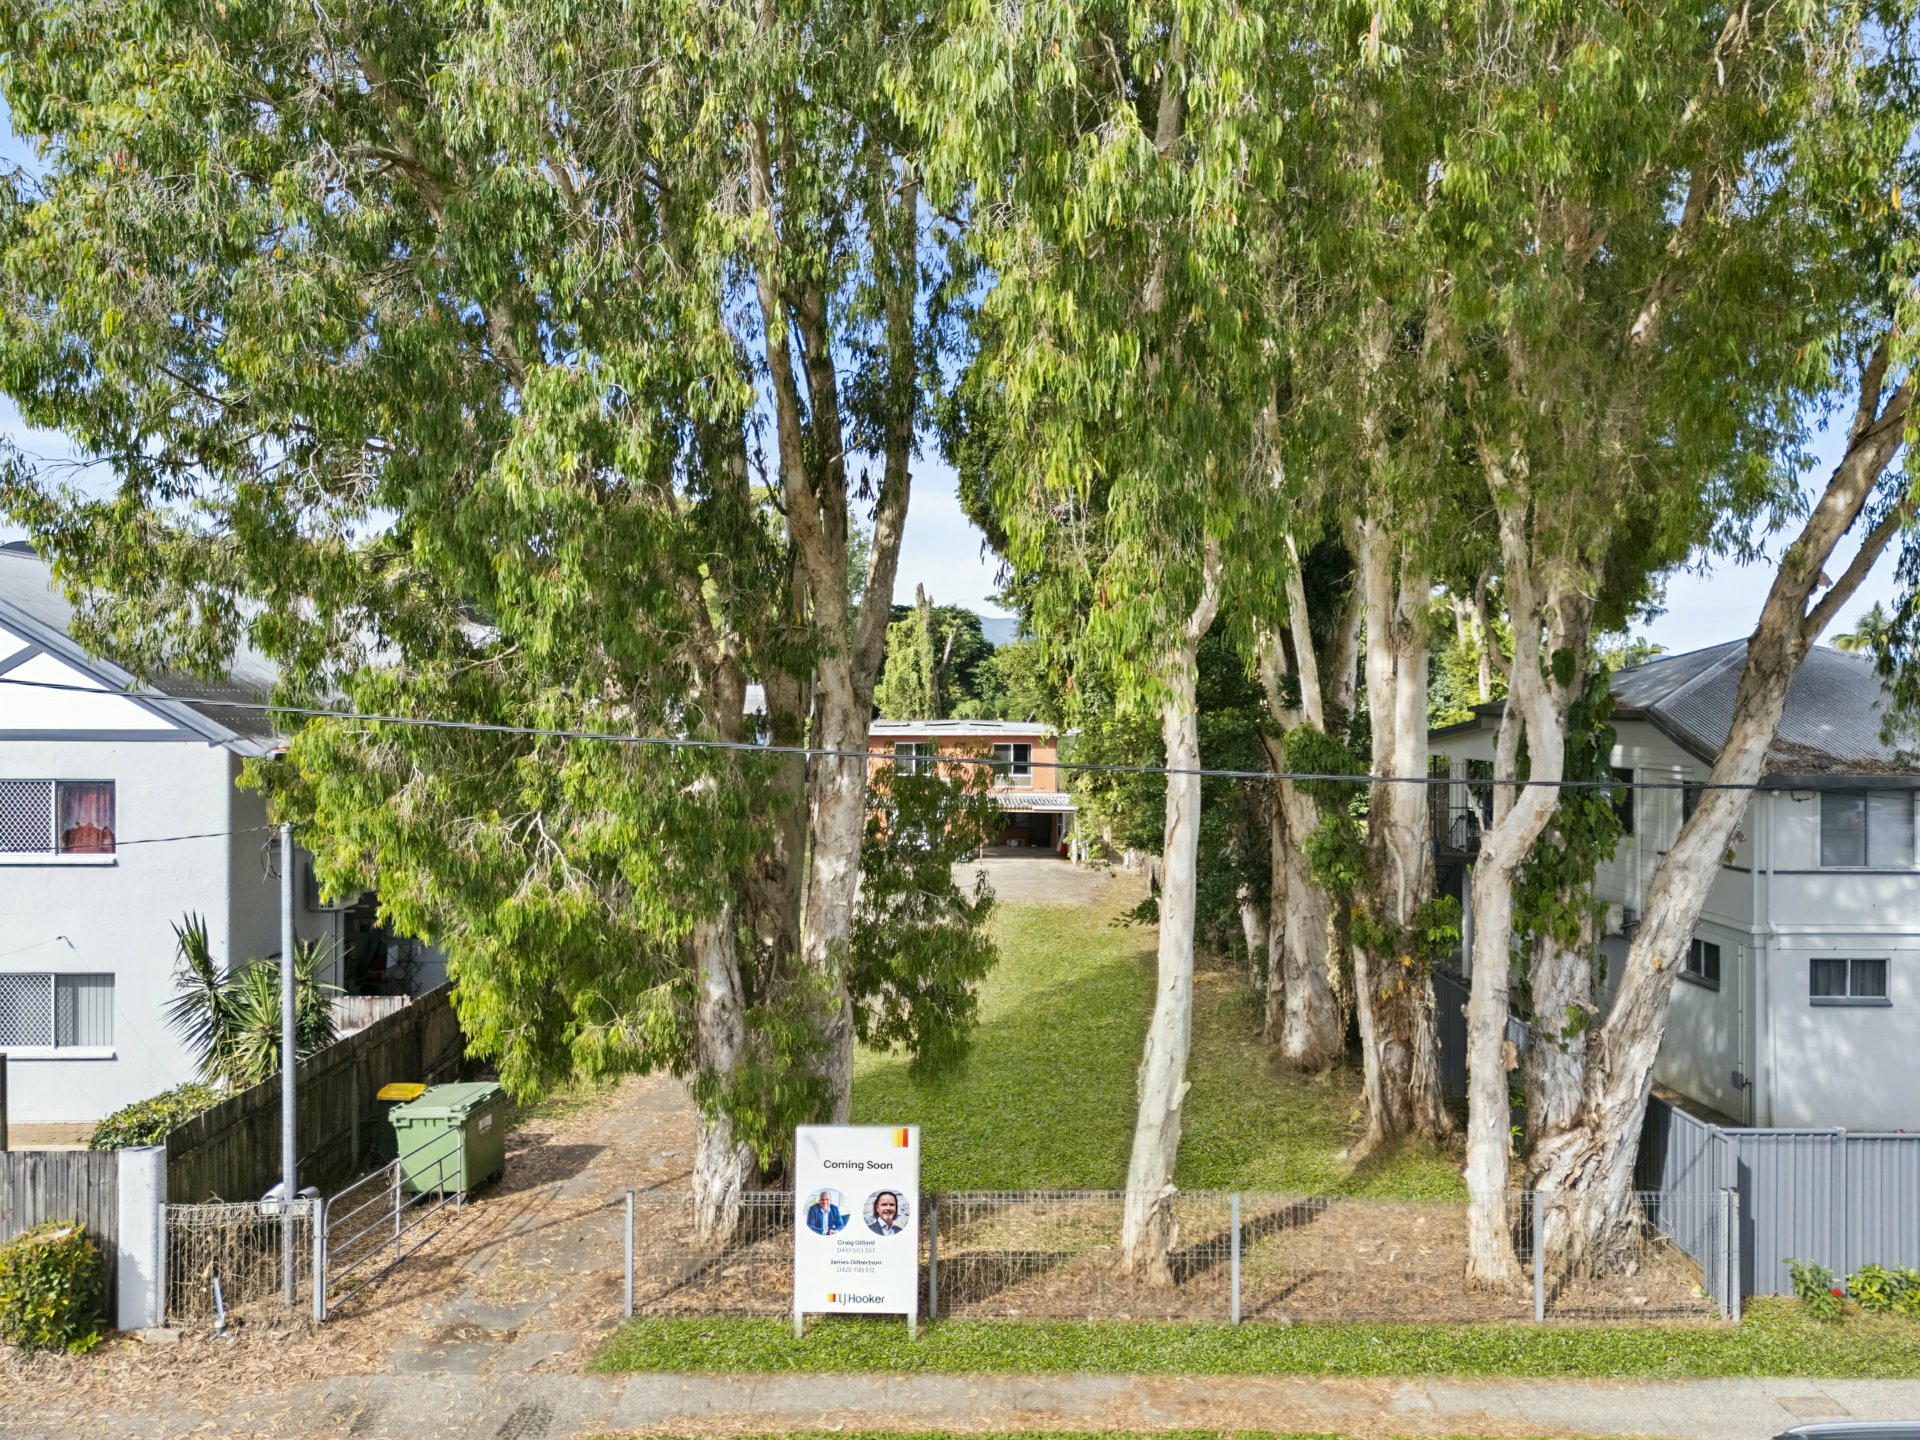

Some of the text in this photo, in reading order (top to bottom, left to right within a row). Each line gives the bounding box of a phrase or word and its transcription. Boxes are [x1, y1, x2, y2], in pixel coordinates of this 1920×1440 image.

[823, 1159, 893, 1172] Coming Soon
[838, 1293, 885, 1306] LJ Hooker
